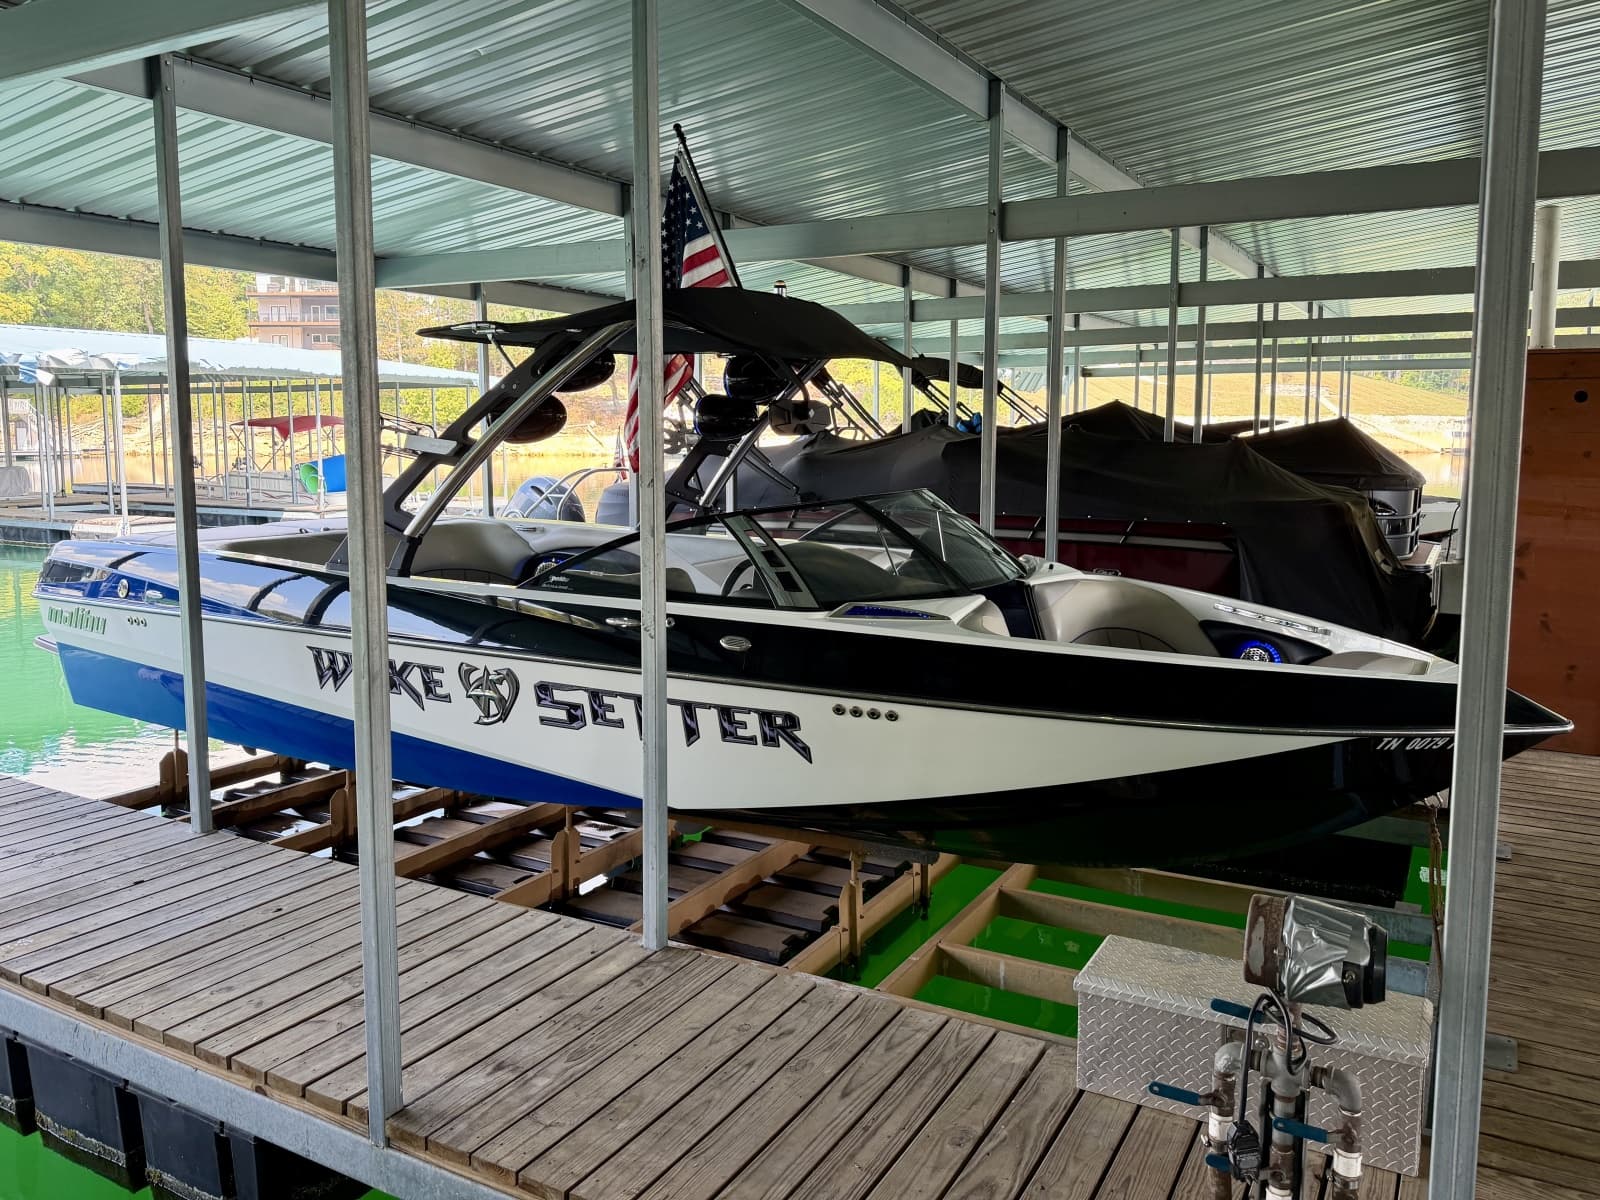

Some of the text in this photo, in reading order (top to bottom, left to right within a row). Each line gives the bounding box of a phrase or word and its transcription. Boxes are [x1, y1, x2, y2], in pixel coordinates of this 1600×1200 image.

[48, 606, 107, 635] malibu
[306, 645, 813, 764] WKE SETER
[1376, 737, 1405, 750] TN
[1405, 737, 1451, 750] 0079
